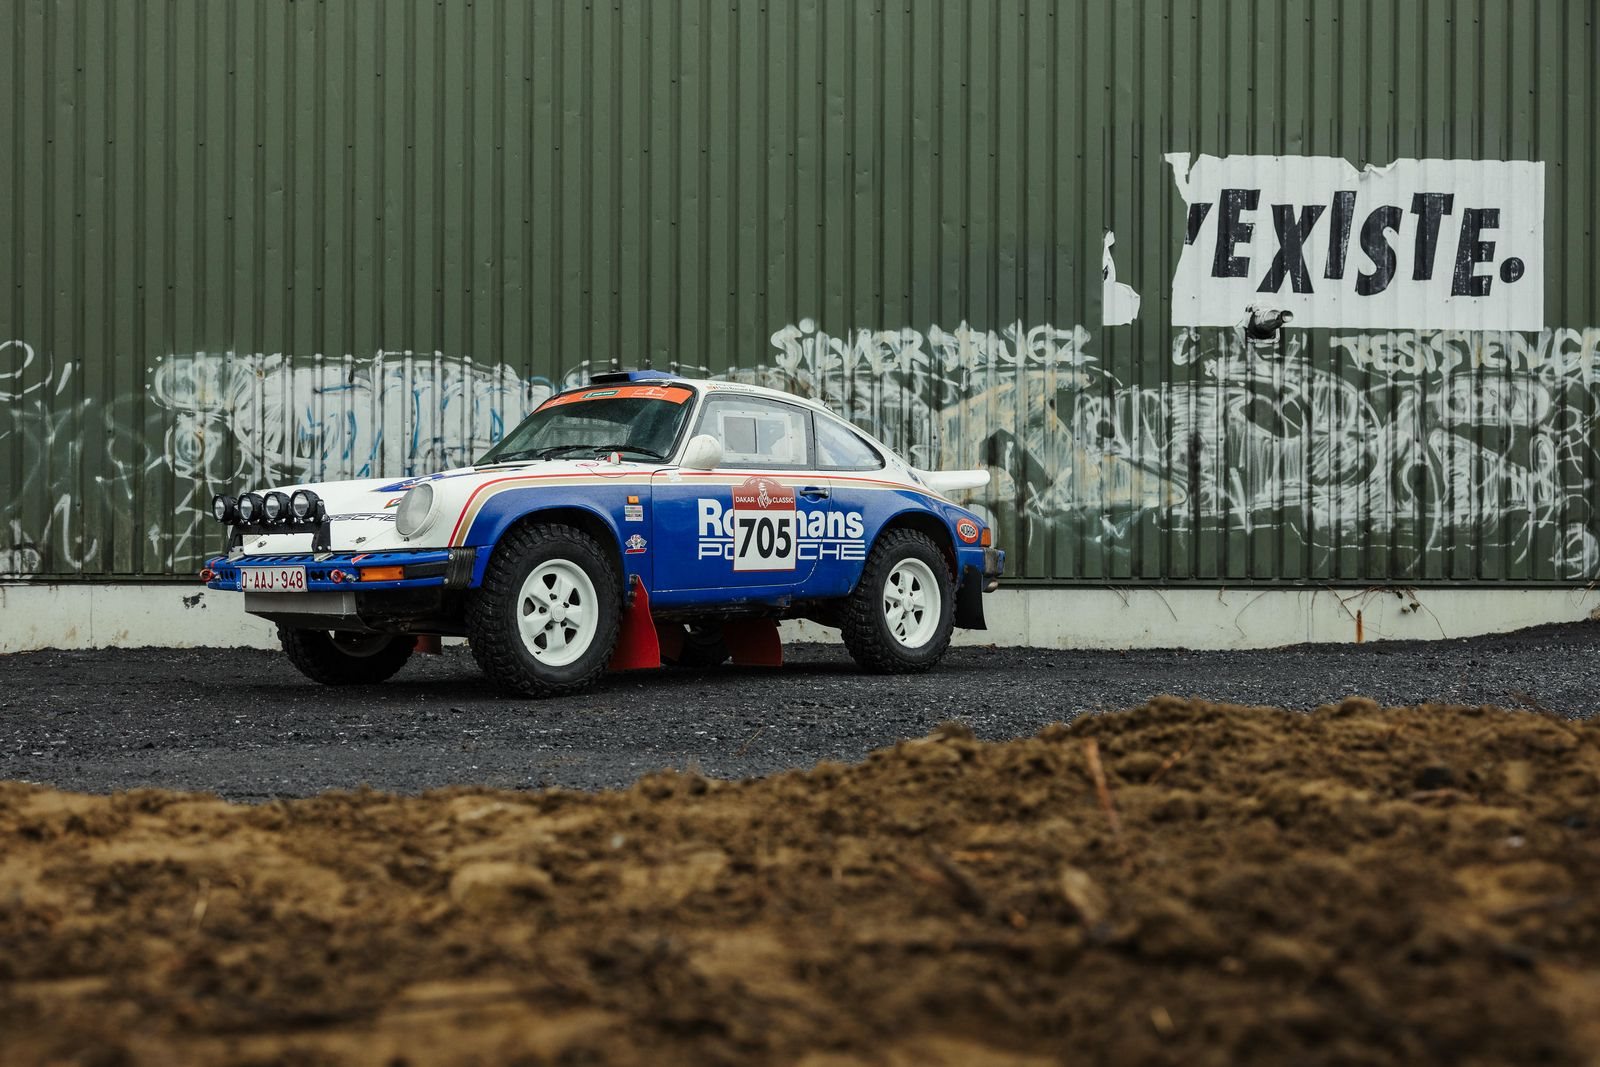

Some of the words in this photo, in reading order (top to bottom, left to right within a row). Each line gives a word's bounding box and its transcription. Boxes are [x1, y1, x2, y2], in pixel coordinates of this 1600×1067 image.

[698, 499, 864, 539] Roans
[738, 517, 792, 559] 705
[698, 543, 866, 561] PCHE
